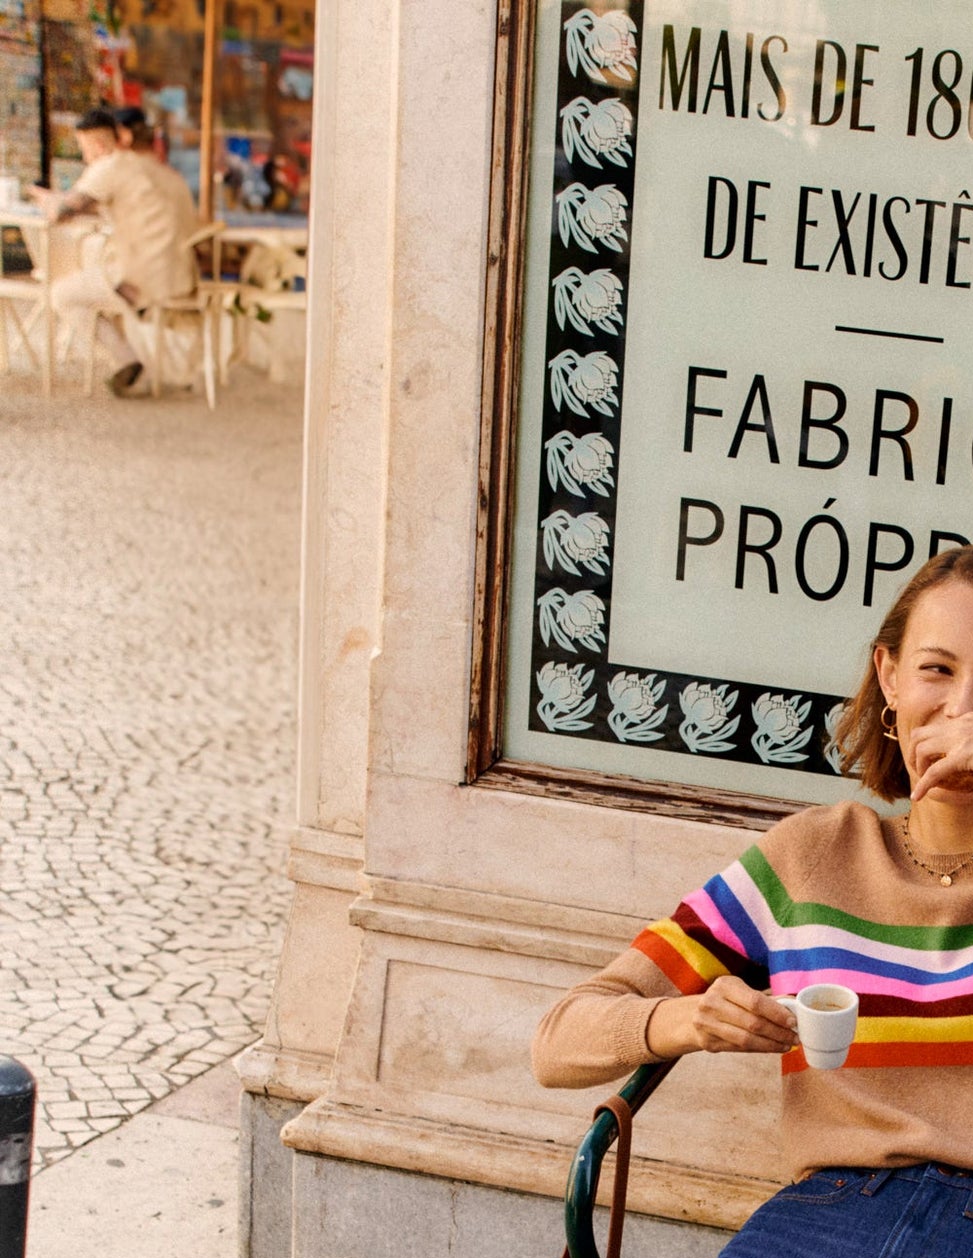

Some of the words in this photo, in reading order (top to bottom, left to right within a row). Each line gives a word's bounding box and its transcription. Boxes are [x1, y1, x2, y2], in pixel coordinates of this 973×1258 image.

[659, 24, 788, 121] MAIS
[811, 39, 879, 132] DE
[703, 176, 771, 266] DE
